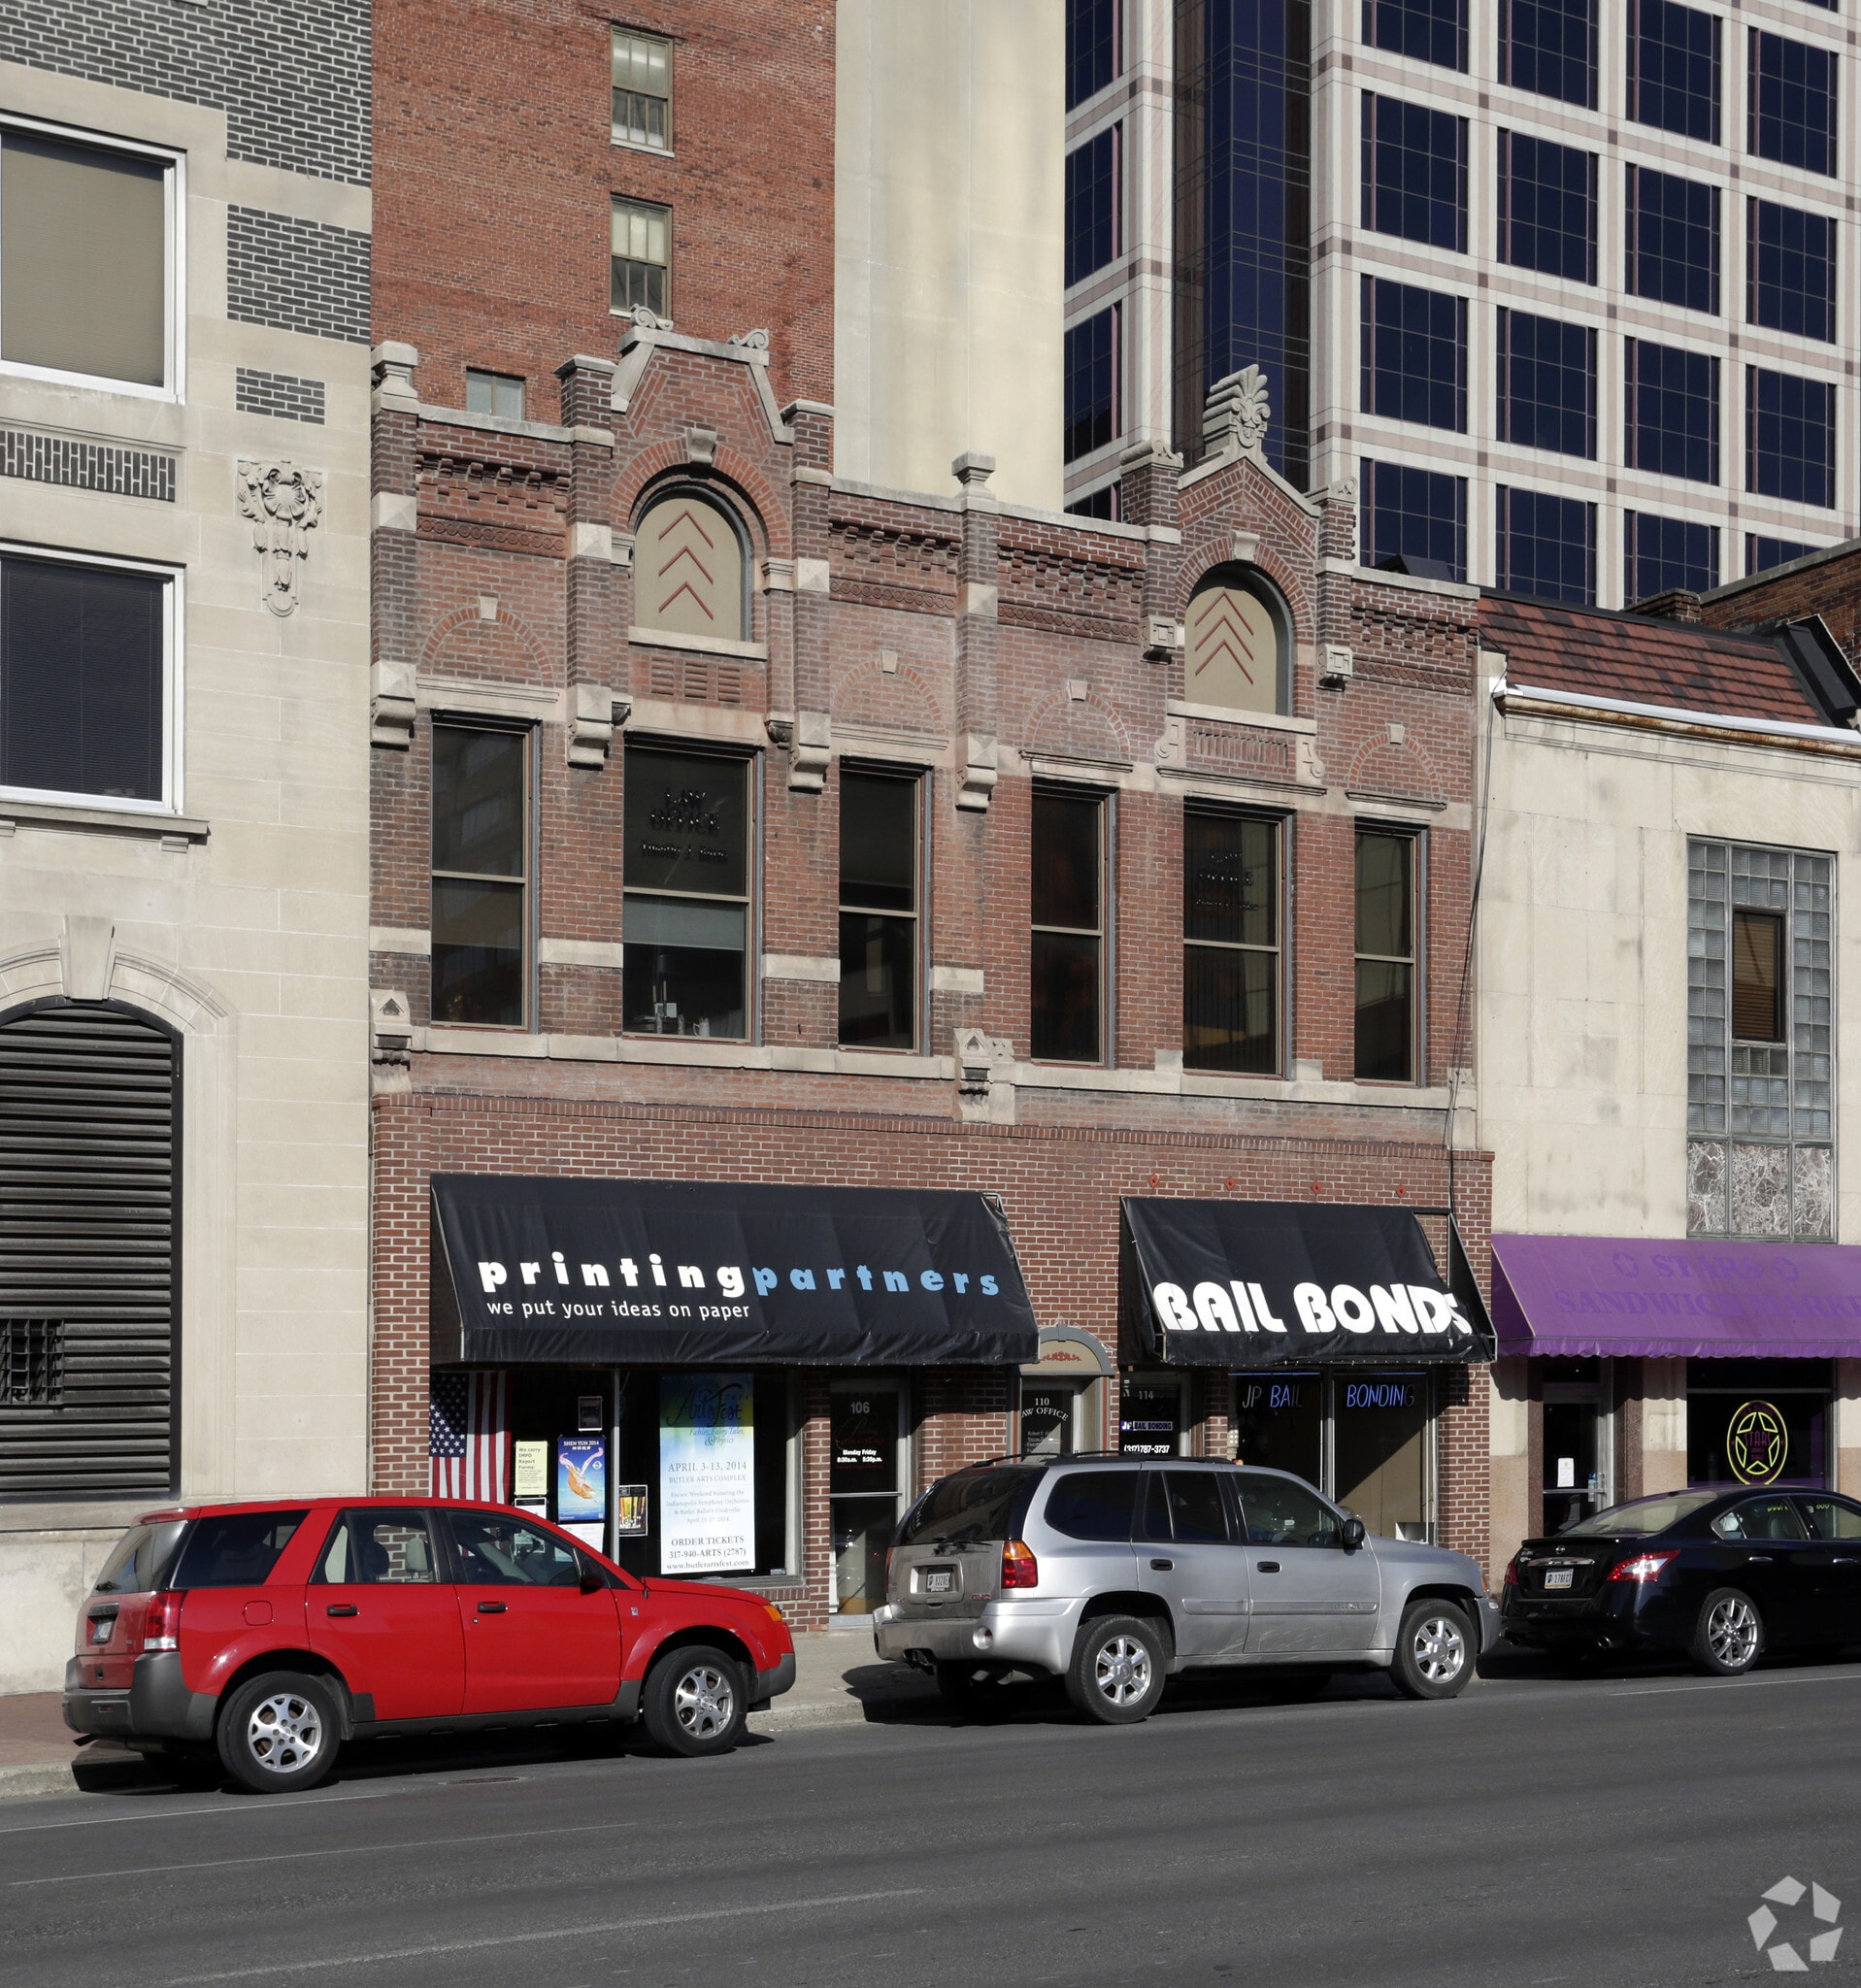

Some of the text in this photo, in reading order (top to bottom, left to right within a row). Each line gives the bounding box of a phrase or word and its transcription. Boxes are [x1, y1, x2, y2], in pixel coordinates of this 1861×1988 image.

[1651, 1254, 1764, 1279] STARS
[1153, 1280, 1474, 1336] BAIL BONDS
[1554, 1289, 1861, 1318] SANDWICH MARKE
[486, 1300, 749, 1321] we put your ideas on paper
[1035, 1397, 1050, 1406] 110
[1139, 1390, 1154, 1400] 114
[1346, 1383, 1415, 1408] BONDING
[850, 1401, 870, 1414] 106
[1021, 1407, 1069, 1421] AW OFFICE
[668, 1461, 748, 1473] APRIL 3-13, 2014
[671, 1536, 745, 1546] ORDER TICKETS
[669, 1547, 747, 1559] 317-940-ARTS (2787)
[666, 1560, 749, 1570] www.butlerartsfest.com
